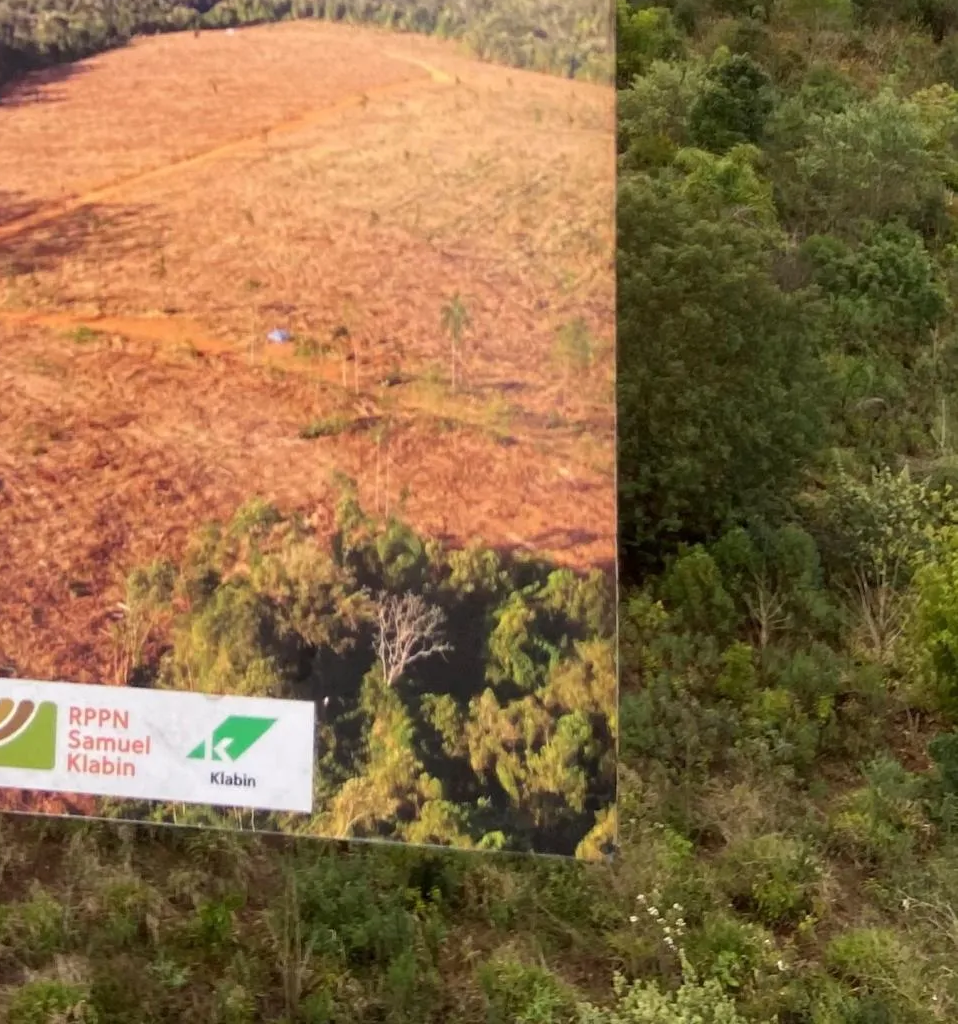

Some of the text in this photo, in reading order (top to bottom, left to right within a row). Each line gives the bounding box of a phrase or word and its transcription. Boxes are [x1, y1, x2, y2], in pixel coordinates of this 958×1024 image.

[68, 706, 129, 729] RPPN
[68, 730, 151, 754] Samuel
[67, 754, 136, 777] Klabin
[210, 771, 256, 788] Klabin
